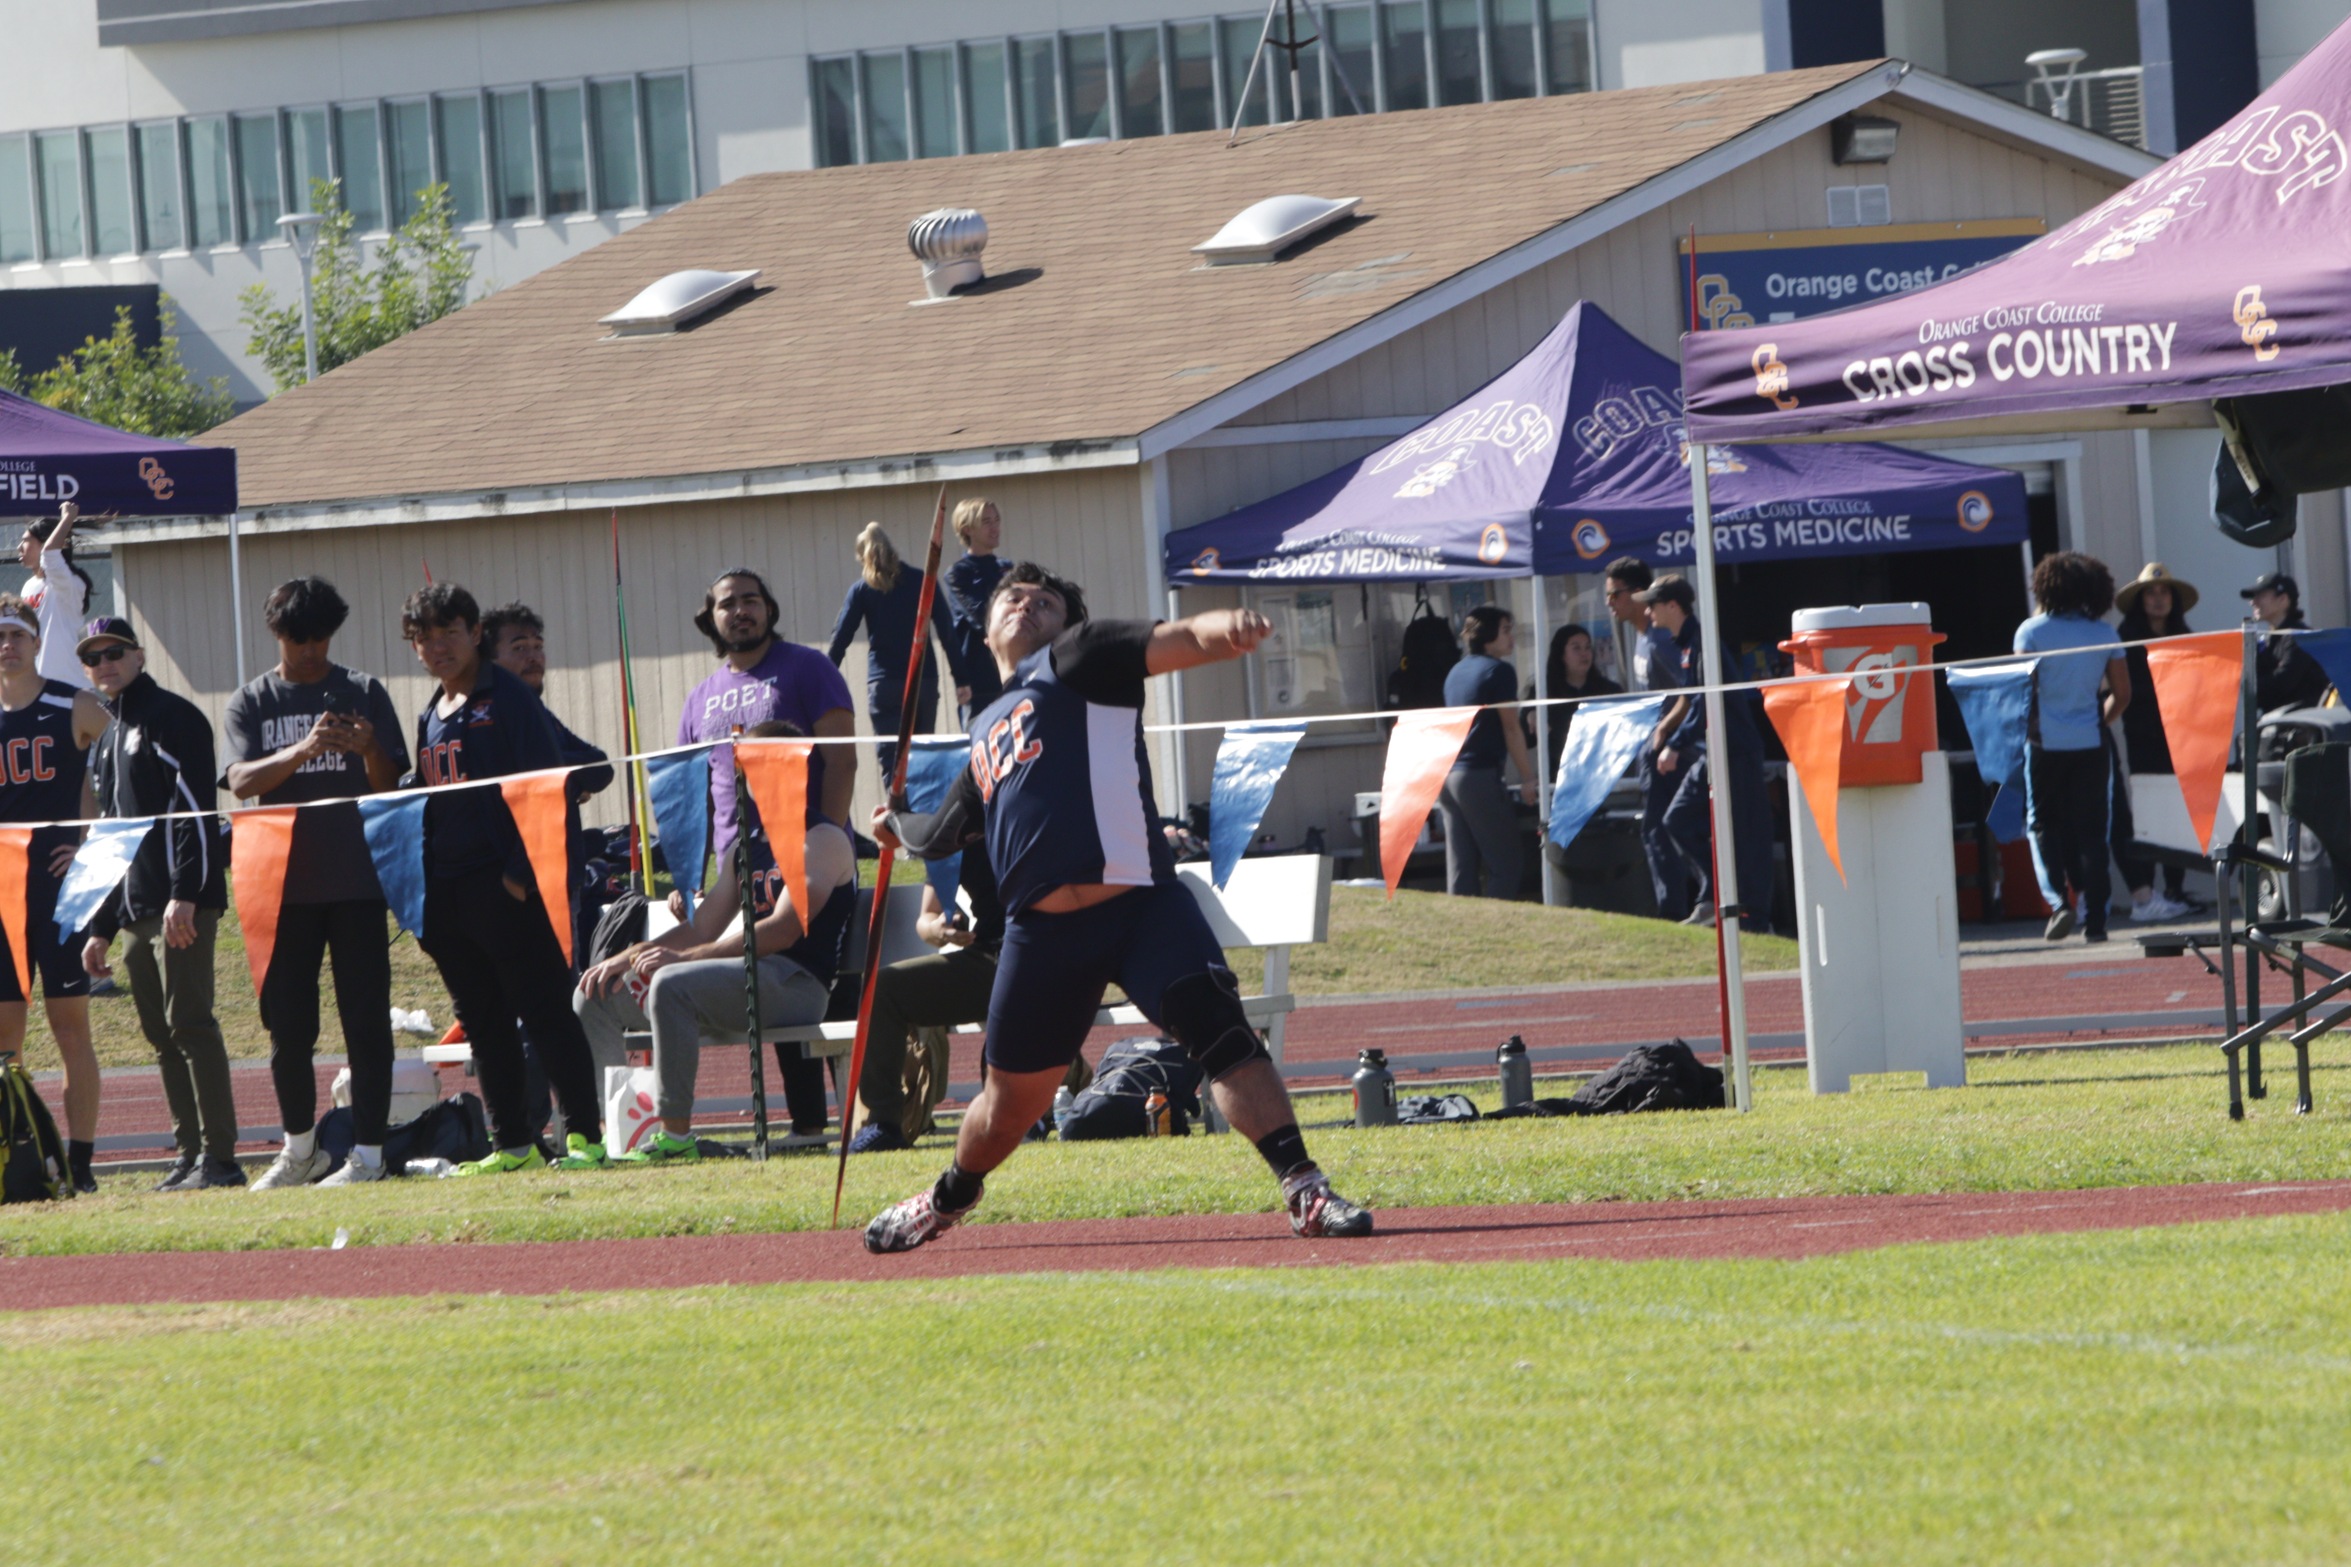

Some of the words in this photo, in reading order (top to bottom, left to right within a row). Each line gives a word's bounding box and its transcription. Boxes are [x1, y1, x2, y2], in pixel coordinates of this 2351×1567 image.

[1766, 265, 1857, 299] Orange
[1865, 264, 1934, 293] Coast
[1918, 315, 1980, 344] ORANGE
[1983, 305, 2034, 331] COAST
[2037, 300, 2104, 325] COLLEGE
[1841, 341, 1977, 403] CROSS
[1987, 321, 2178, 382] COUNTRY
[1369, 400, 1553, 467] COAST
[1573, 385, 1684, 461] COA
[1656, 522, 1767, 557] SPRTS
[1774, 515, 1912, 547] MEDICINE
[1248, 550, 1336, 579] SPORTS
[1339, 546, 1447, 575] MEDICINE
[703, 676, 778, 719] POET
[262, 713, 312, 752] RANGE
[971, 698, 1043, 804] OCC
[0, 735, 56, 786] CC
[421, 739, 469, 788] OCC
